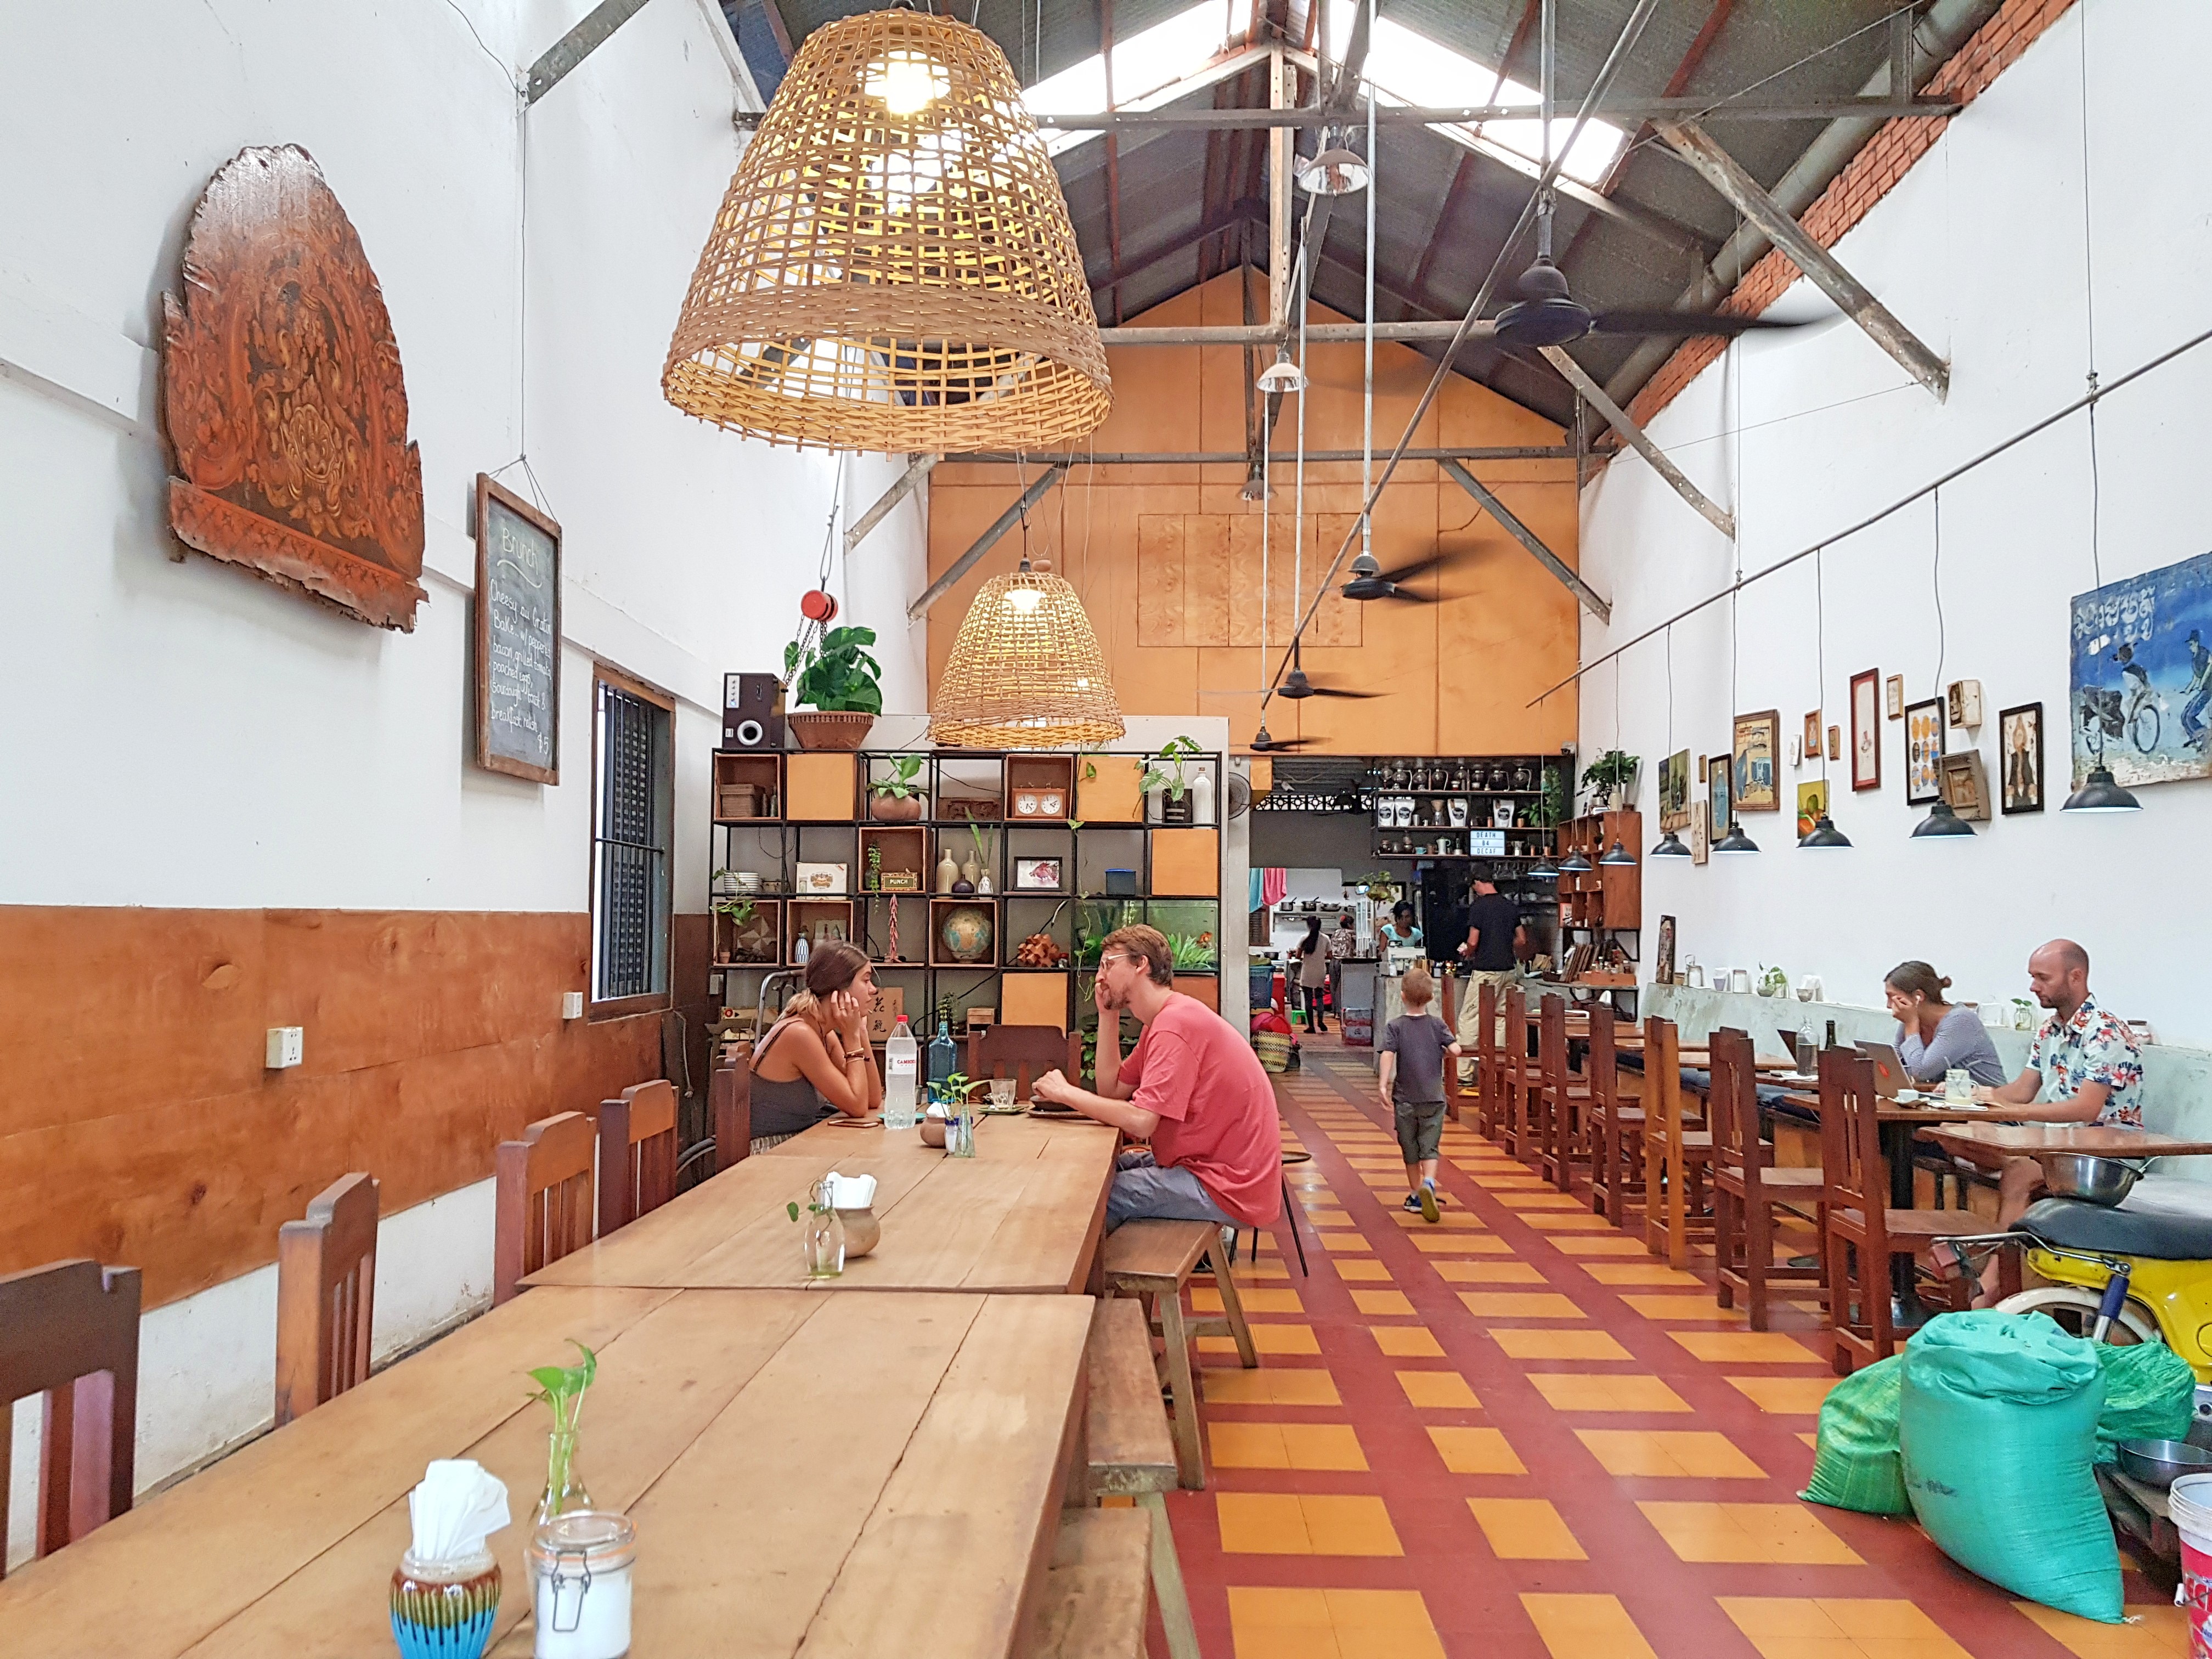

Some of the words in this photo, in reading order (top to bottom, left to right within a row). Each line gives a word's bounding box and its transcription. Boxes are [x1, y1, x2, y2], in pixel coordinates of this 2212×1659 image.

[503, 527, 538, 575] Brunch
[490, 578, 517, 624] Cheesy
[493, 660, 518, 681] poached
[490, 701, 522, 733] breakfast
[523, 711, 538, 732] relish
[537, 732, 549, 755] $5
